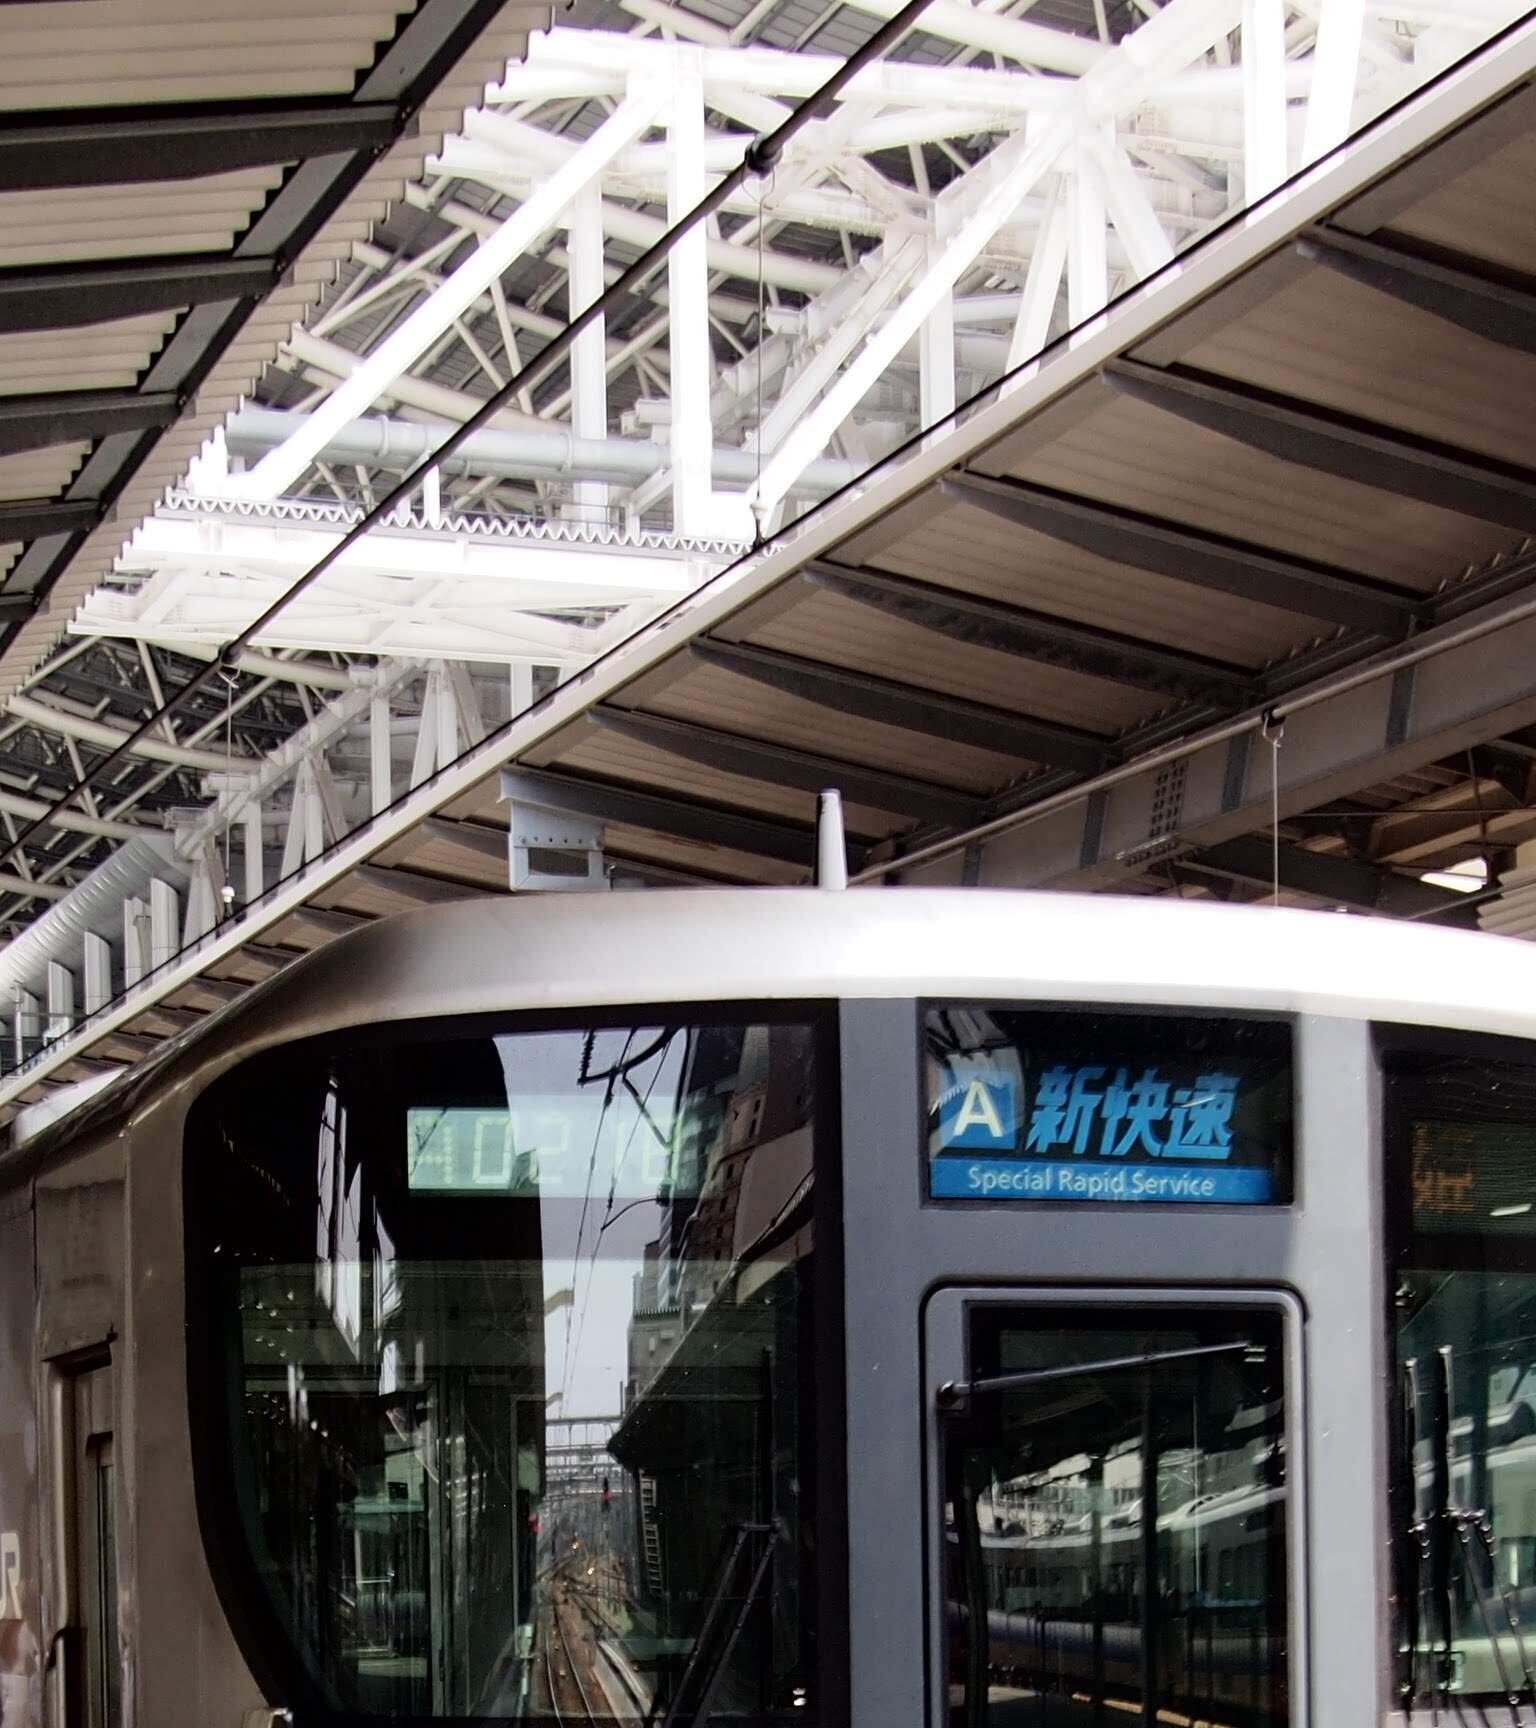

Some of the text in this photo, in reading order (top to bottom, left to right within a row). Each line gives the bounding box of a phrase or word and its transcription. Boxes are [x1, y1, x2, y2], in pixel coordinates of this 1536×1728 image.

[952, 1080, 1003, 1138] A
[1025, 1064, 1242, 1160] 新快速
[968, 1164, 1214, 1197] Special Rapid Service
